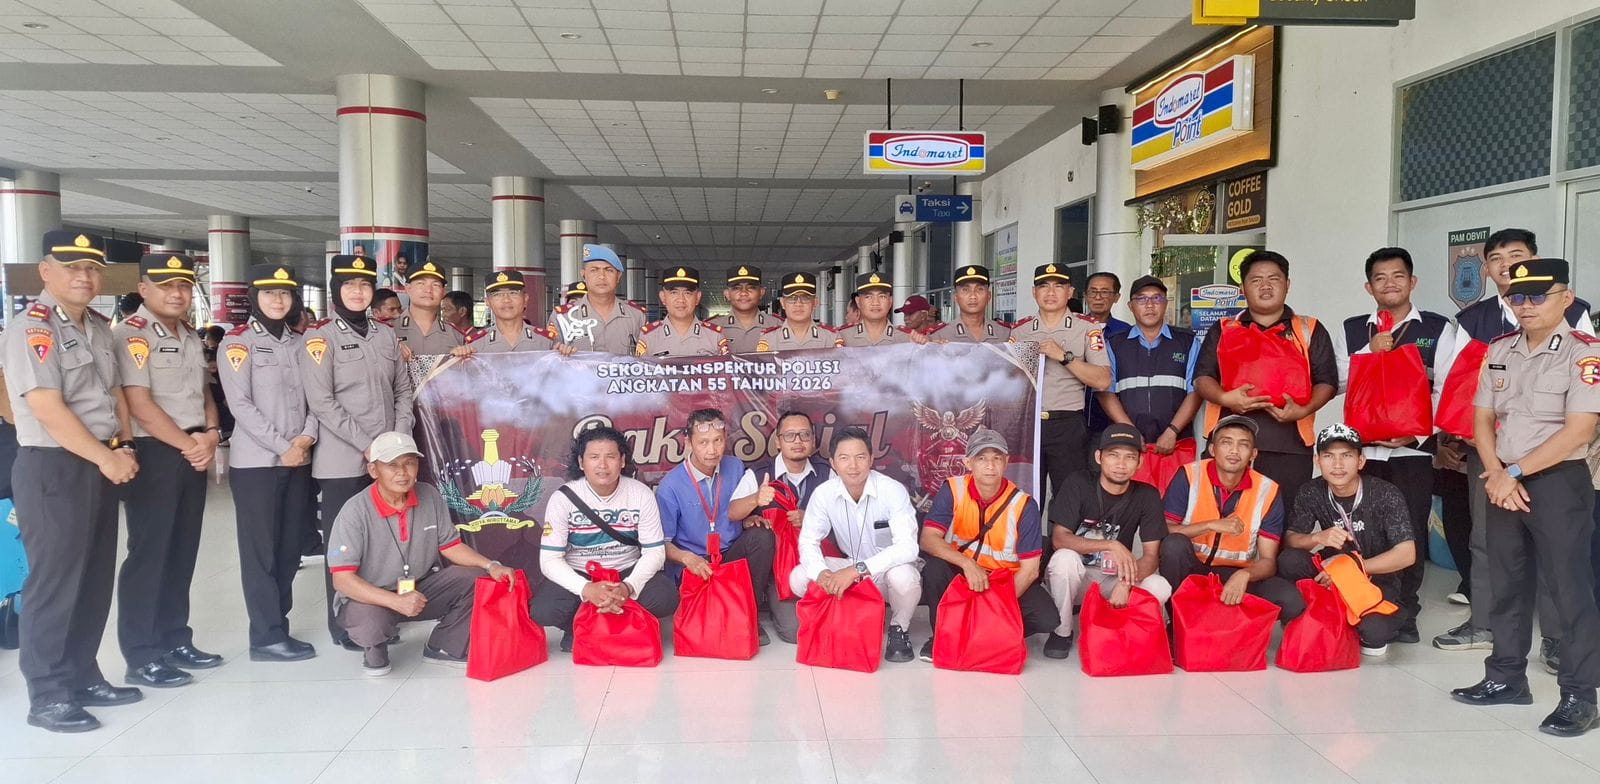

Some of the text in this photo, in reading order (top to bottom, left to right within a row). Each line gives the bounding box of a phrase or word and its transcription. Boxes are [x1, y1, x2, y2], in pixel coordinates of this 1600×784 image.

[1158, 81, 1201, 117] Indomaret
[1172, 110, 1203, 147] Point
[891, 143, 963, 158] Indomaret
[1228, 175, 1261, 197] COFFEE
[921, 198, 951, 207] Taksi
[1227, 198, 1252, 217] GOLD
[933, 209, 951, 217] Taxi
[1450, 230, 1487, 243] PAM OBVIT
[597, 360, 840, 377] SEKOLAH INSPEKTUR POLISI
[607, 376, 832, 393] ANGKATAN 55 TAHUN 2026
